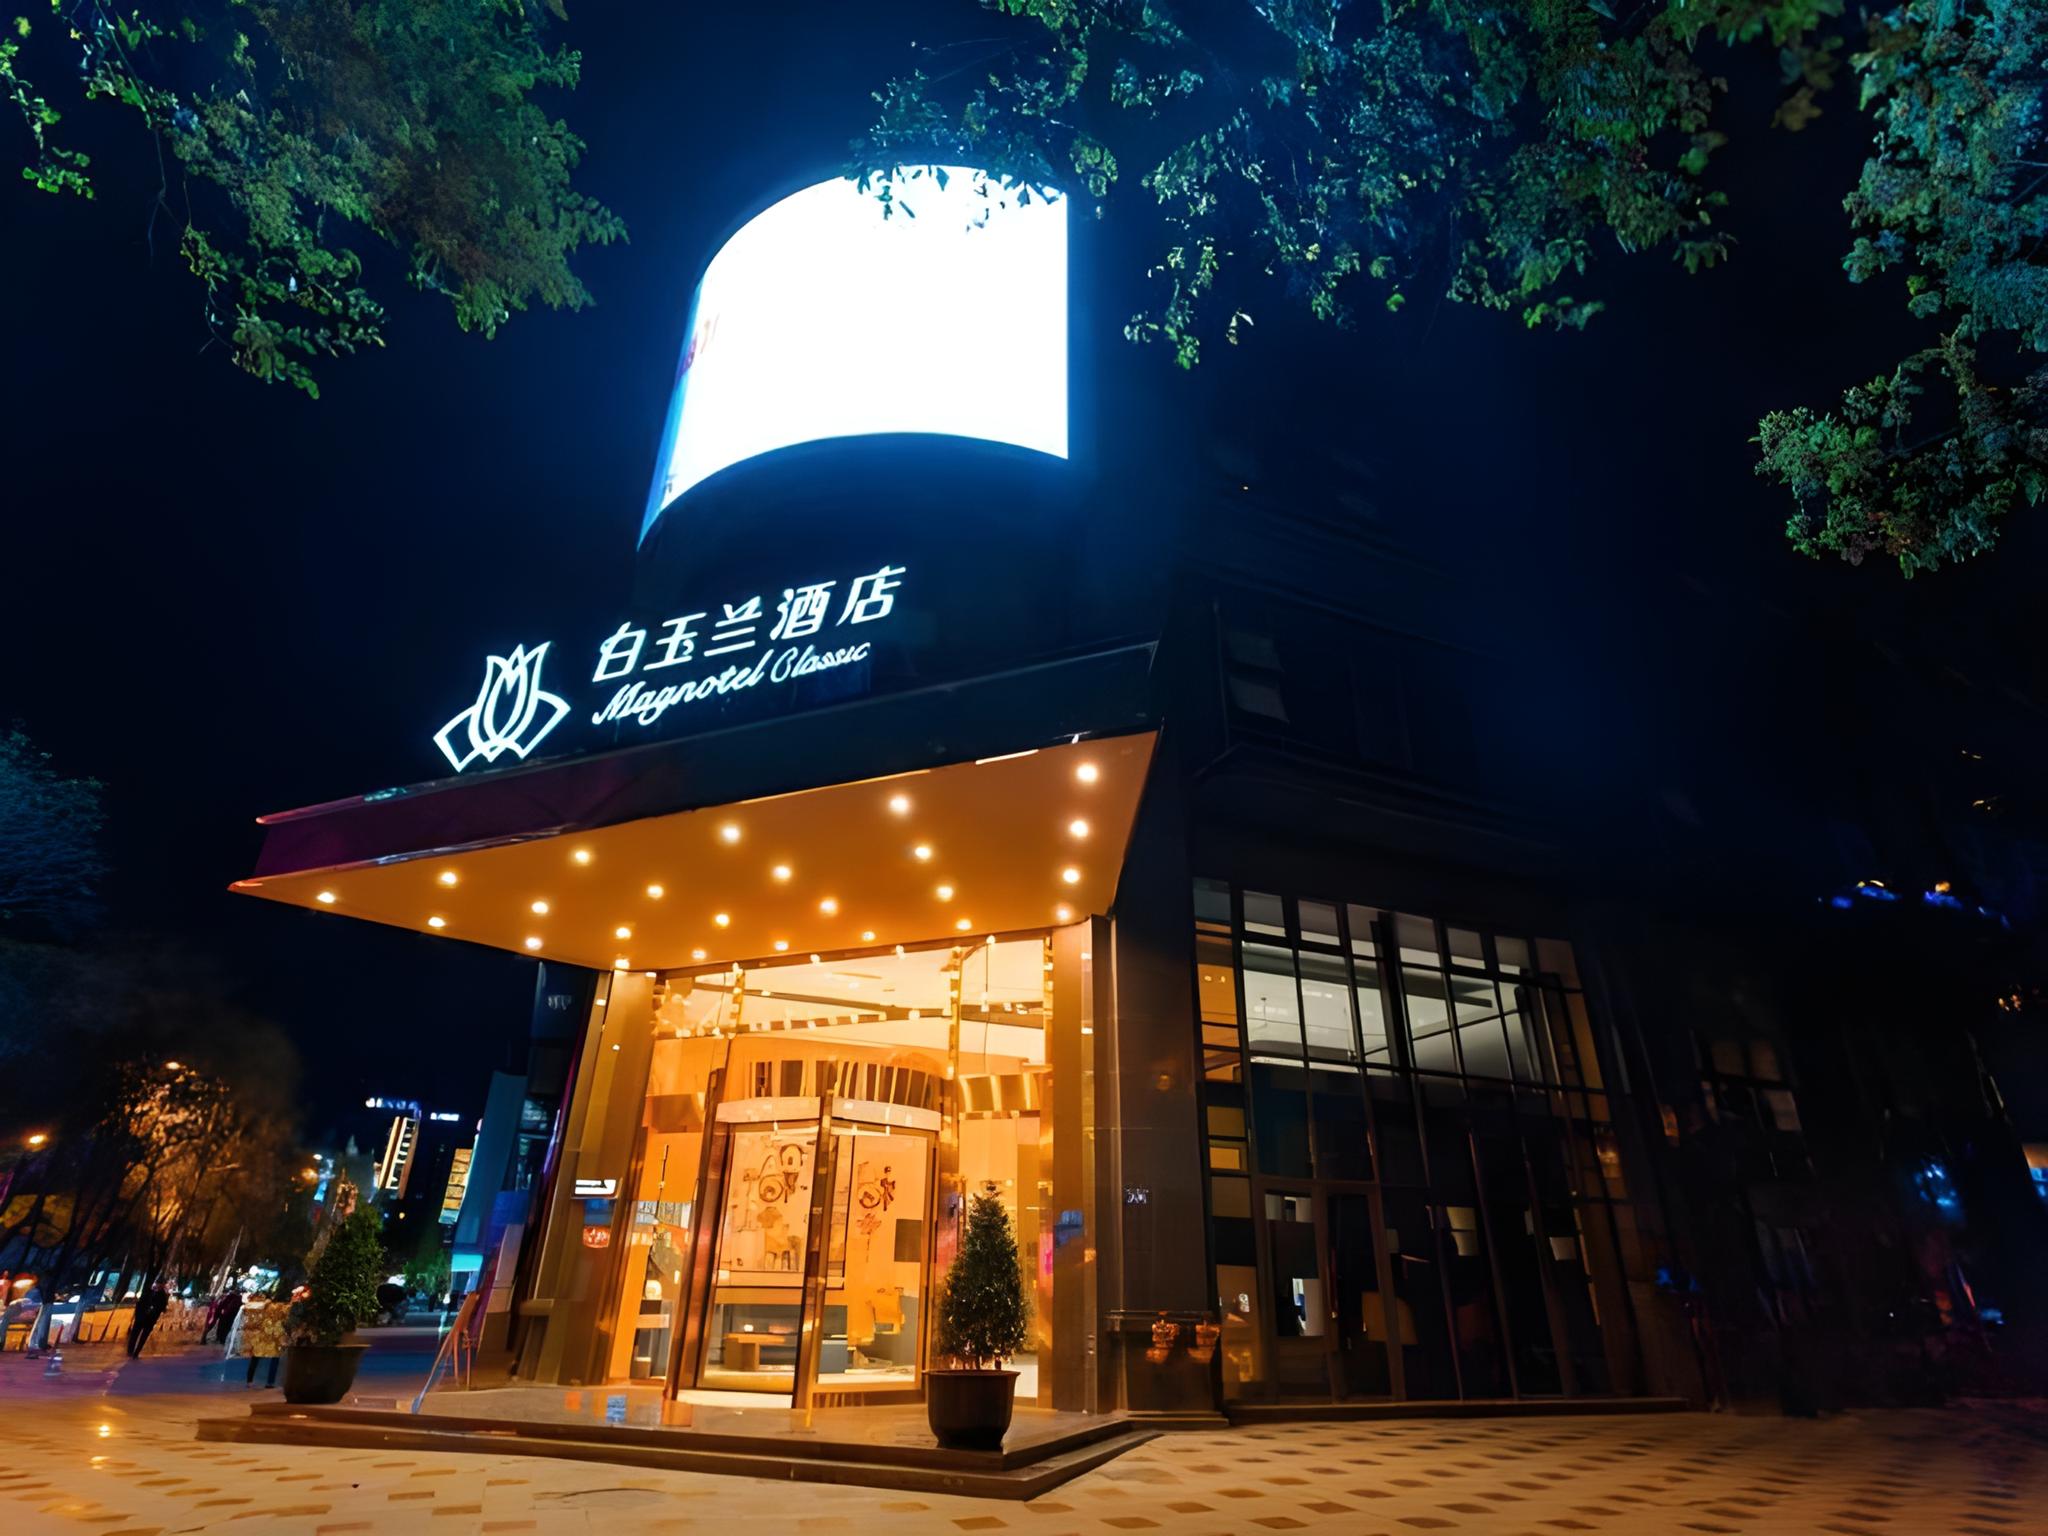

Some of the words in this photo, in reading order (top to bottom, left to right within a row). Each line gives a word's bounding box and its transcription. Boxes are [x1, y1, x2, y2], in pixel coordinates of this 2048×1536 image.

[592, 566, 906, 683] 白玉兰酒店
[592, 649, 775, 726] Magnotel
[770, 642, 871, 683] Classic
